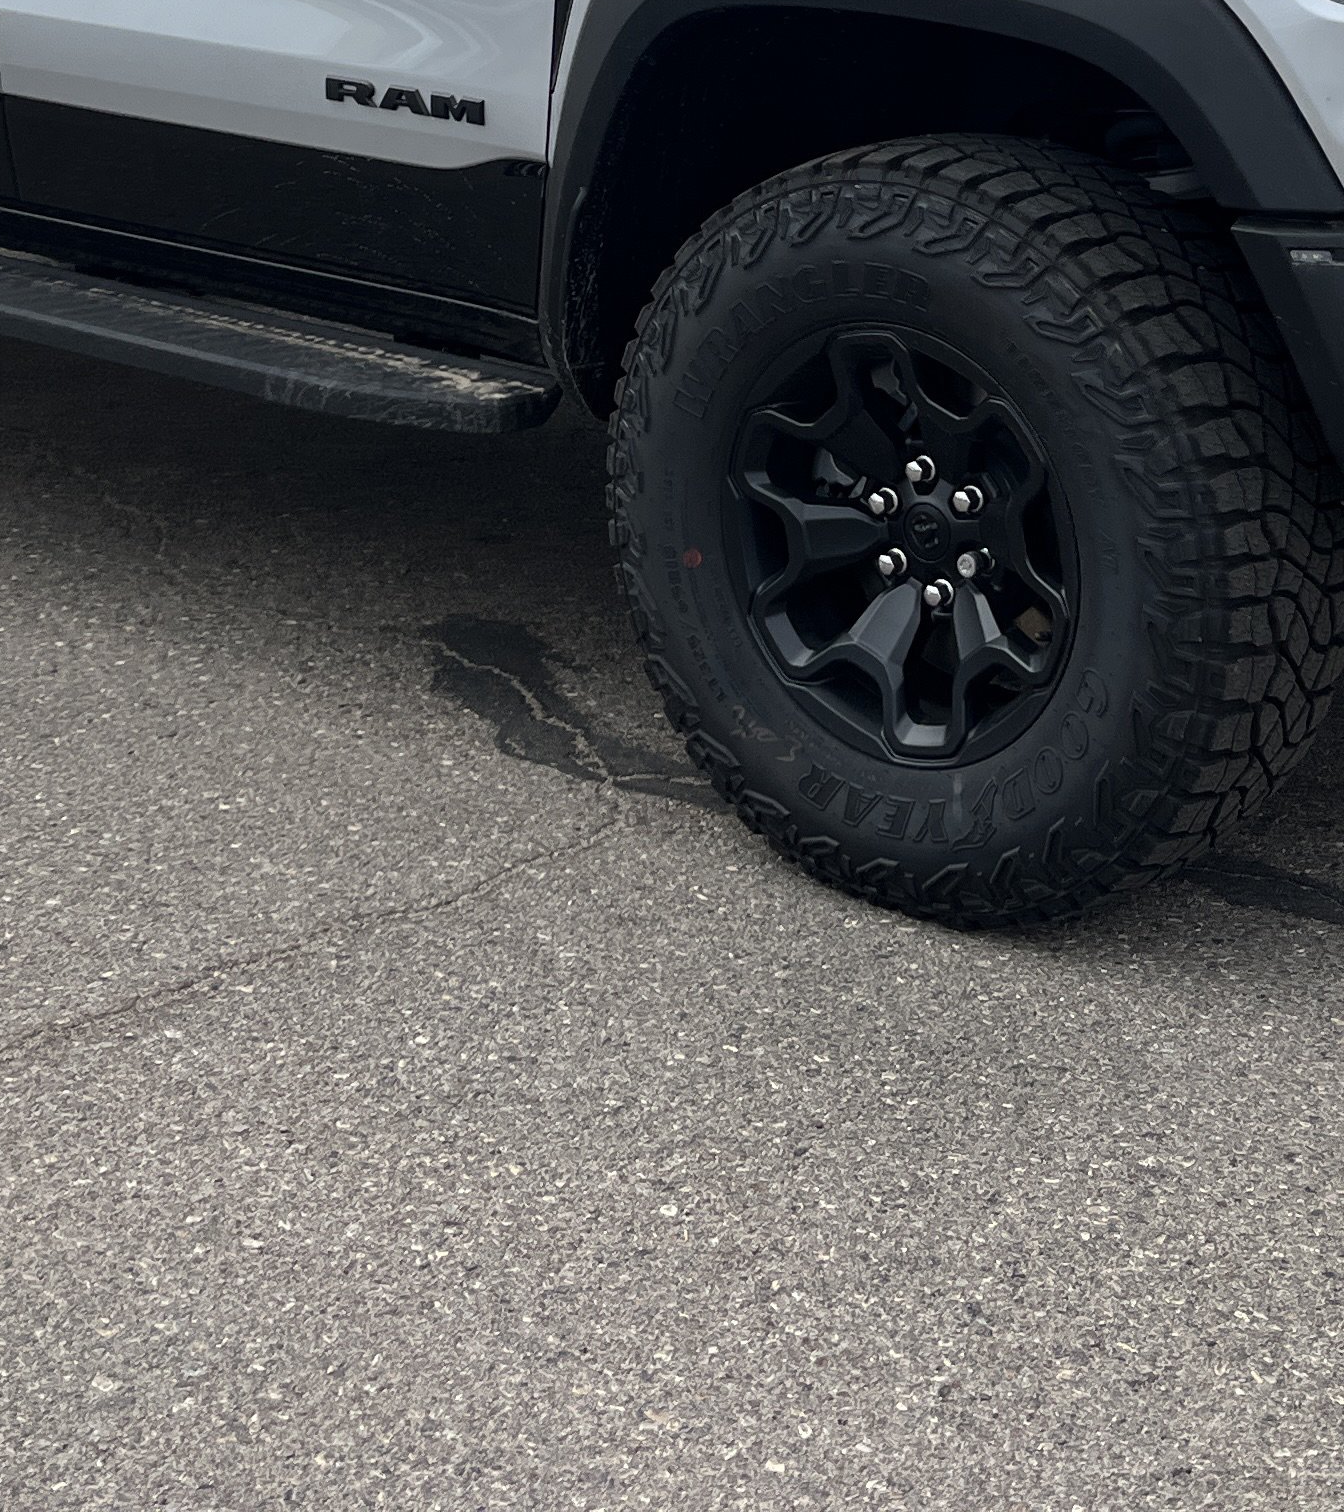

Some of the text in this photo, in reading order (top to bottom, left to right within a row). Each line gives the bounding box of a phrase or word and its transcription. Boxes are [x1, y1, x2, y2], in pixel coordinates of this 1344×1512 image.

[325, 74, 485, 126] RAM
[671, 258, 933, 419] WRANGLER
[797, 666, 1110, 848] GOODYEAR
